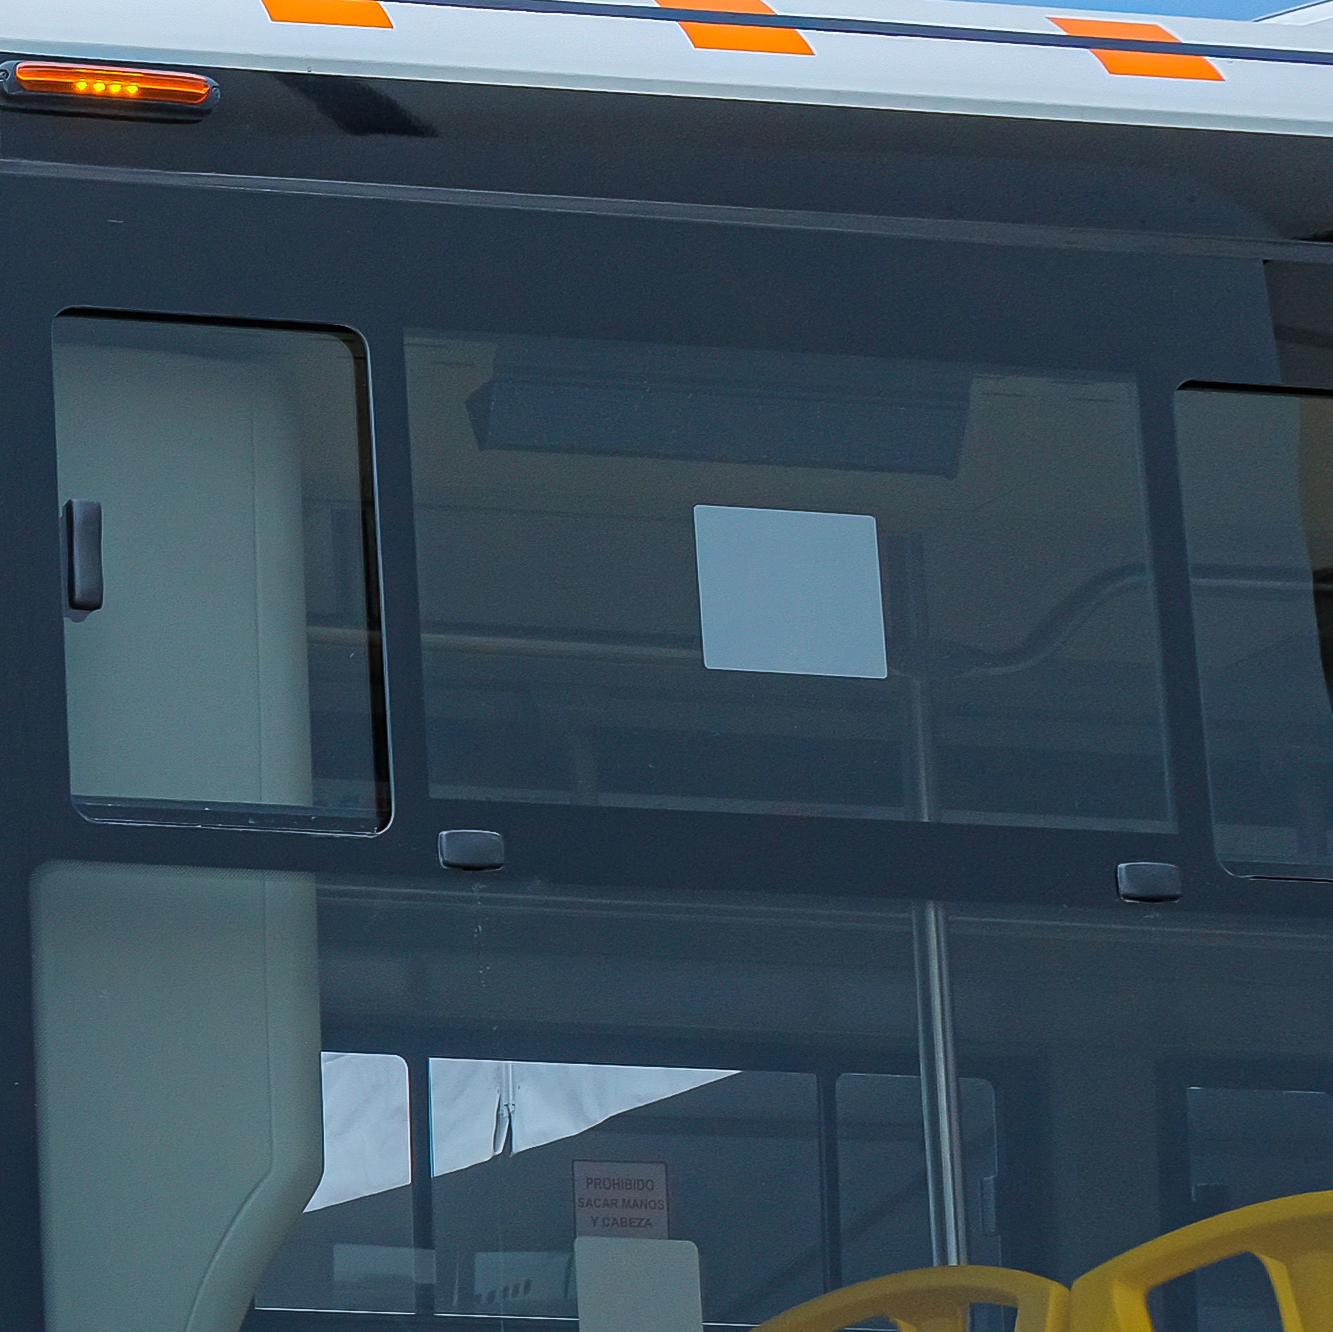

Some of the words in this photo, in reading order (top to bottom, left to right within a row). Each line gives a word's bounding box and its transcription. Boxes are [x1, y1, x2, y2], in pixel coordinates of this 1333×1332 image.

[585, 1177, 655, 1191] PROHIBIDO
[577, 1197, 619, 1209] SACAR
[622, 1199, 665, 1210] MANOS
[590, 1216, 599, 1227] Y
[602, 1217, 653, 1228] CABEZA
